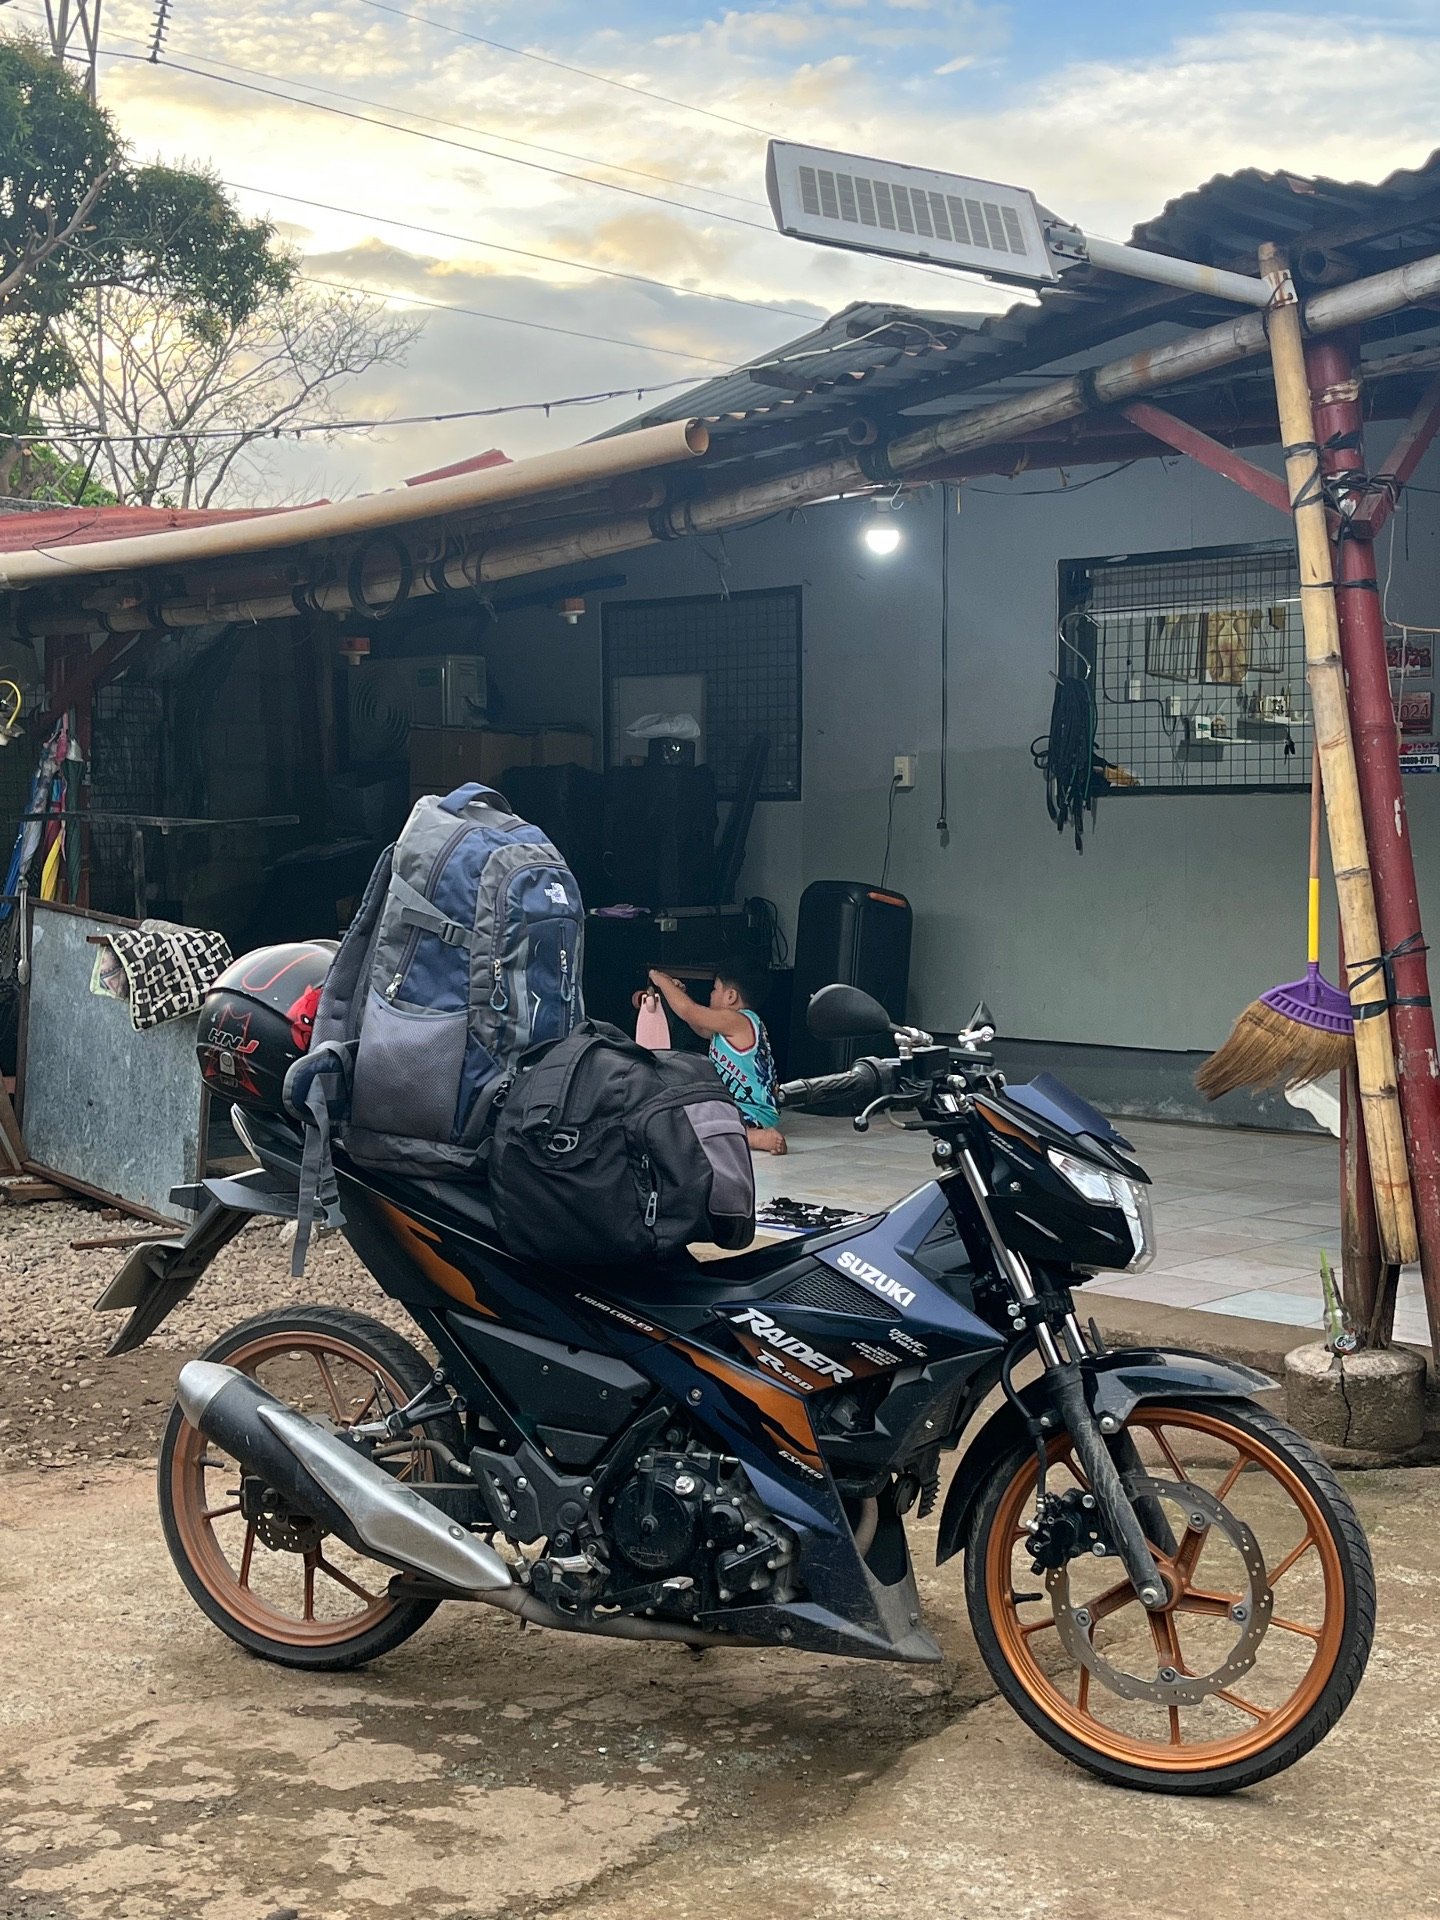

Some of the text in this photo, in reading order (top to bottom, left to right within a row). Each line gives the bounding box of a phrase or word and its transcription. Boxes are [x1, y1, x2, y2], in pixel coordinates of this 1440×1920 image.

[208, 1027, 260, 1054] HNJ
[711, 1047, 748, 1082] MPHIS
[836, 1251, 916, 1308] SUZUKI
[574, 1292, 654, 1332] LIQUID COOLED
[729, 1307, 854, 1385] RAIDER
